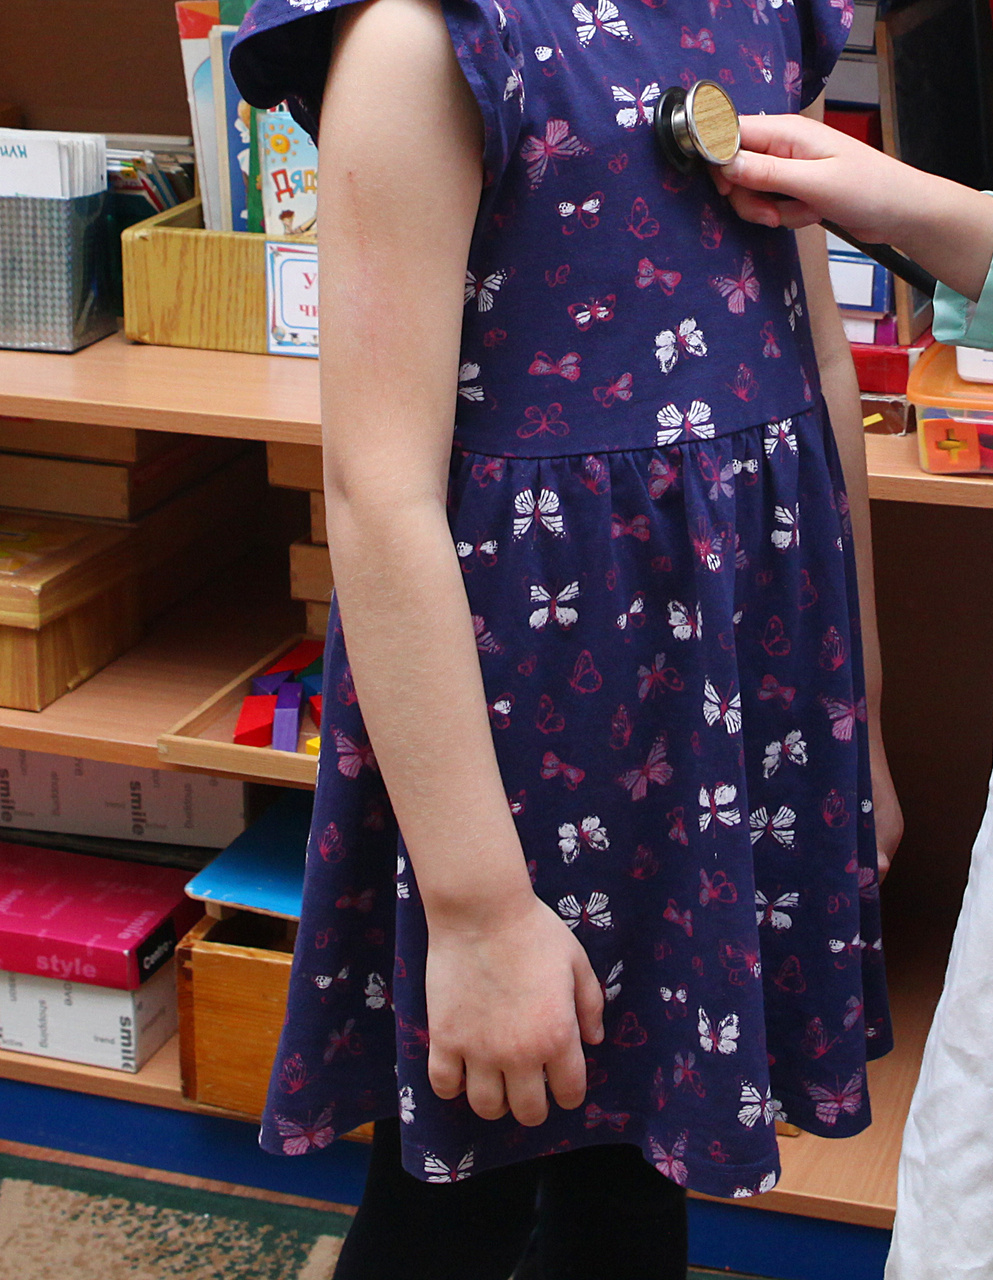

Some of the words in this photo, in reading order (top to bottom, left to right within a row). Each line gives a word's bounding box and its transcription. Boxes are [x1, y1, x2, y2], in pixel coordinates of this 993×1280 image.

[276, 168, 319, 204] ДЯД
[129, 780, 148, 836] smile
[36, 954, 98, 979] style
